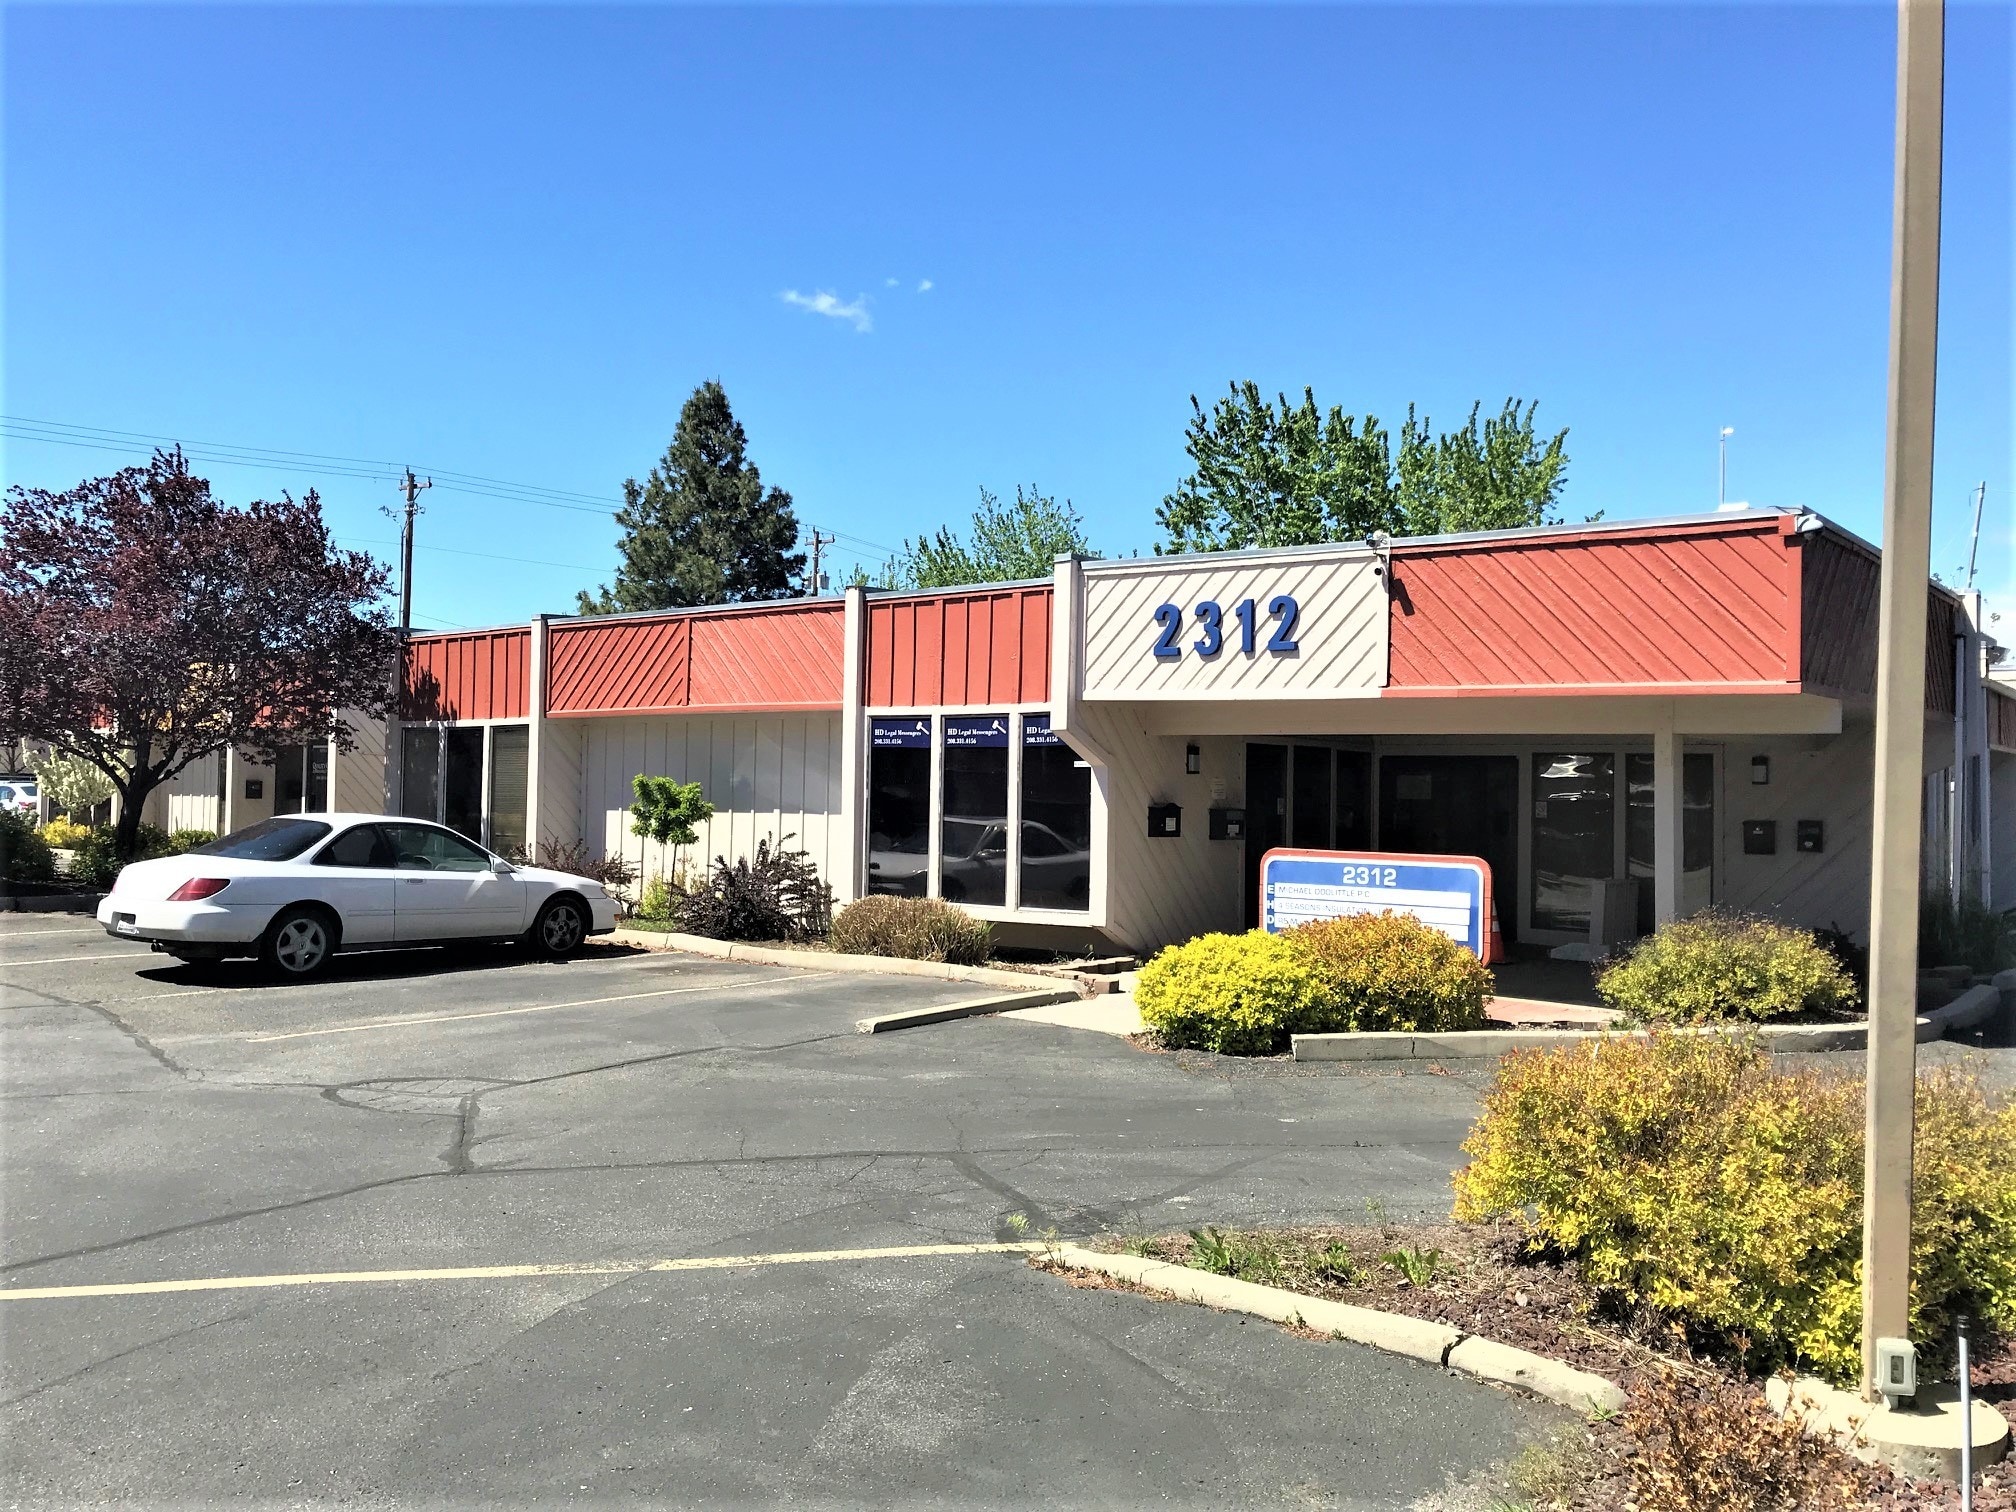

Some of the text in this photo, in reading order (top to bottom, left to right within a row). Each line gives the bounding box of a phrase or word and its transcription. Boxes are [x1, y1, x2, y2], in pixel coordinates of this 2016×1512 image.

[1153, 595, 1299, 656] 2312
[1342, 866, 1397, 887] 2312
[1278, 886, 1312, 895] MICHAEL
[1314, 888, 1355, 897] DOOLITTLE
[1285, 902, 1321, 912] SEASONS
